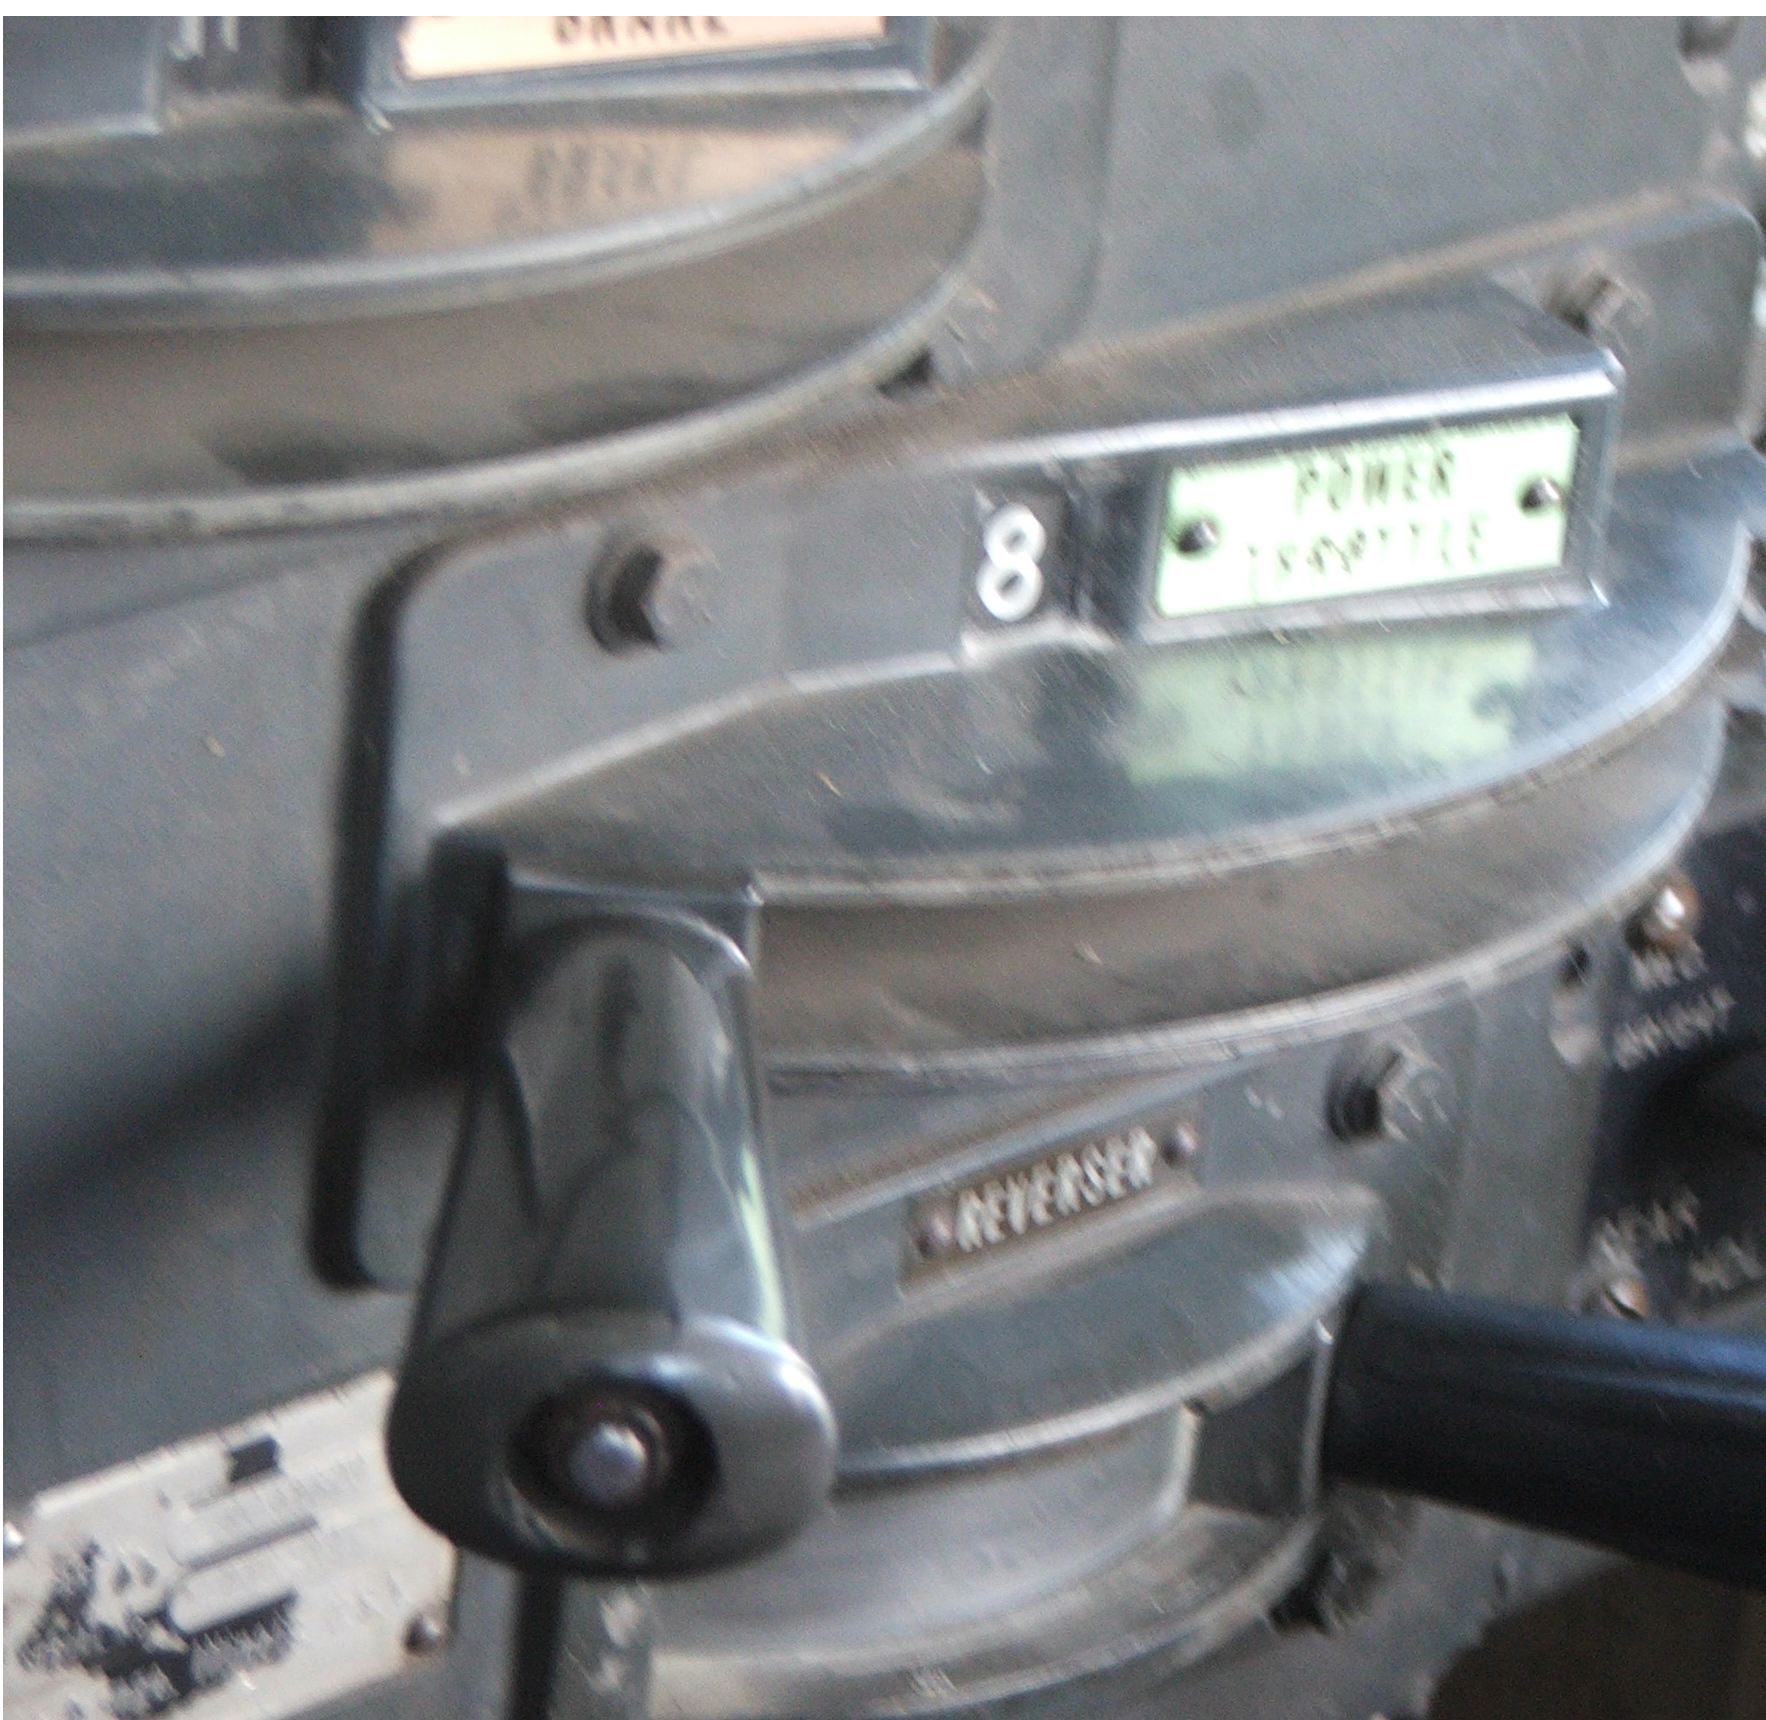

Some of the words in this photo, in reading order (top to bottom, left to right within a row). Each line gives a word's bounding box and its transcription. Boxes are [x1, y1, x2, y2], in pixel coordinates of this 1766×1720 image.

[1294, 447, 1457, 515] POWER
[976, 503, 1046, 623] 8
[954, 1125, 1158, 1252] REVERSER
